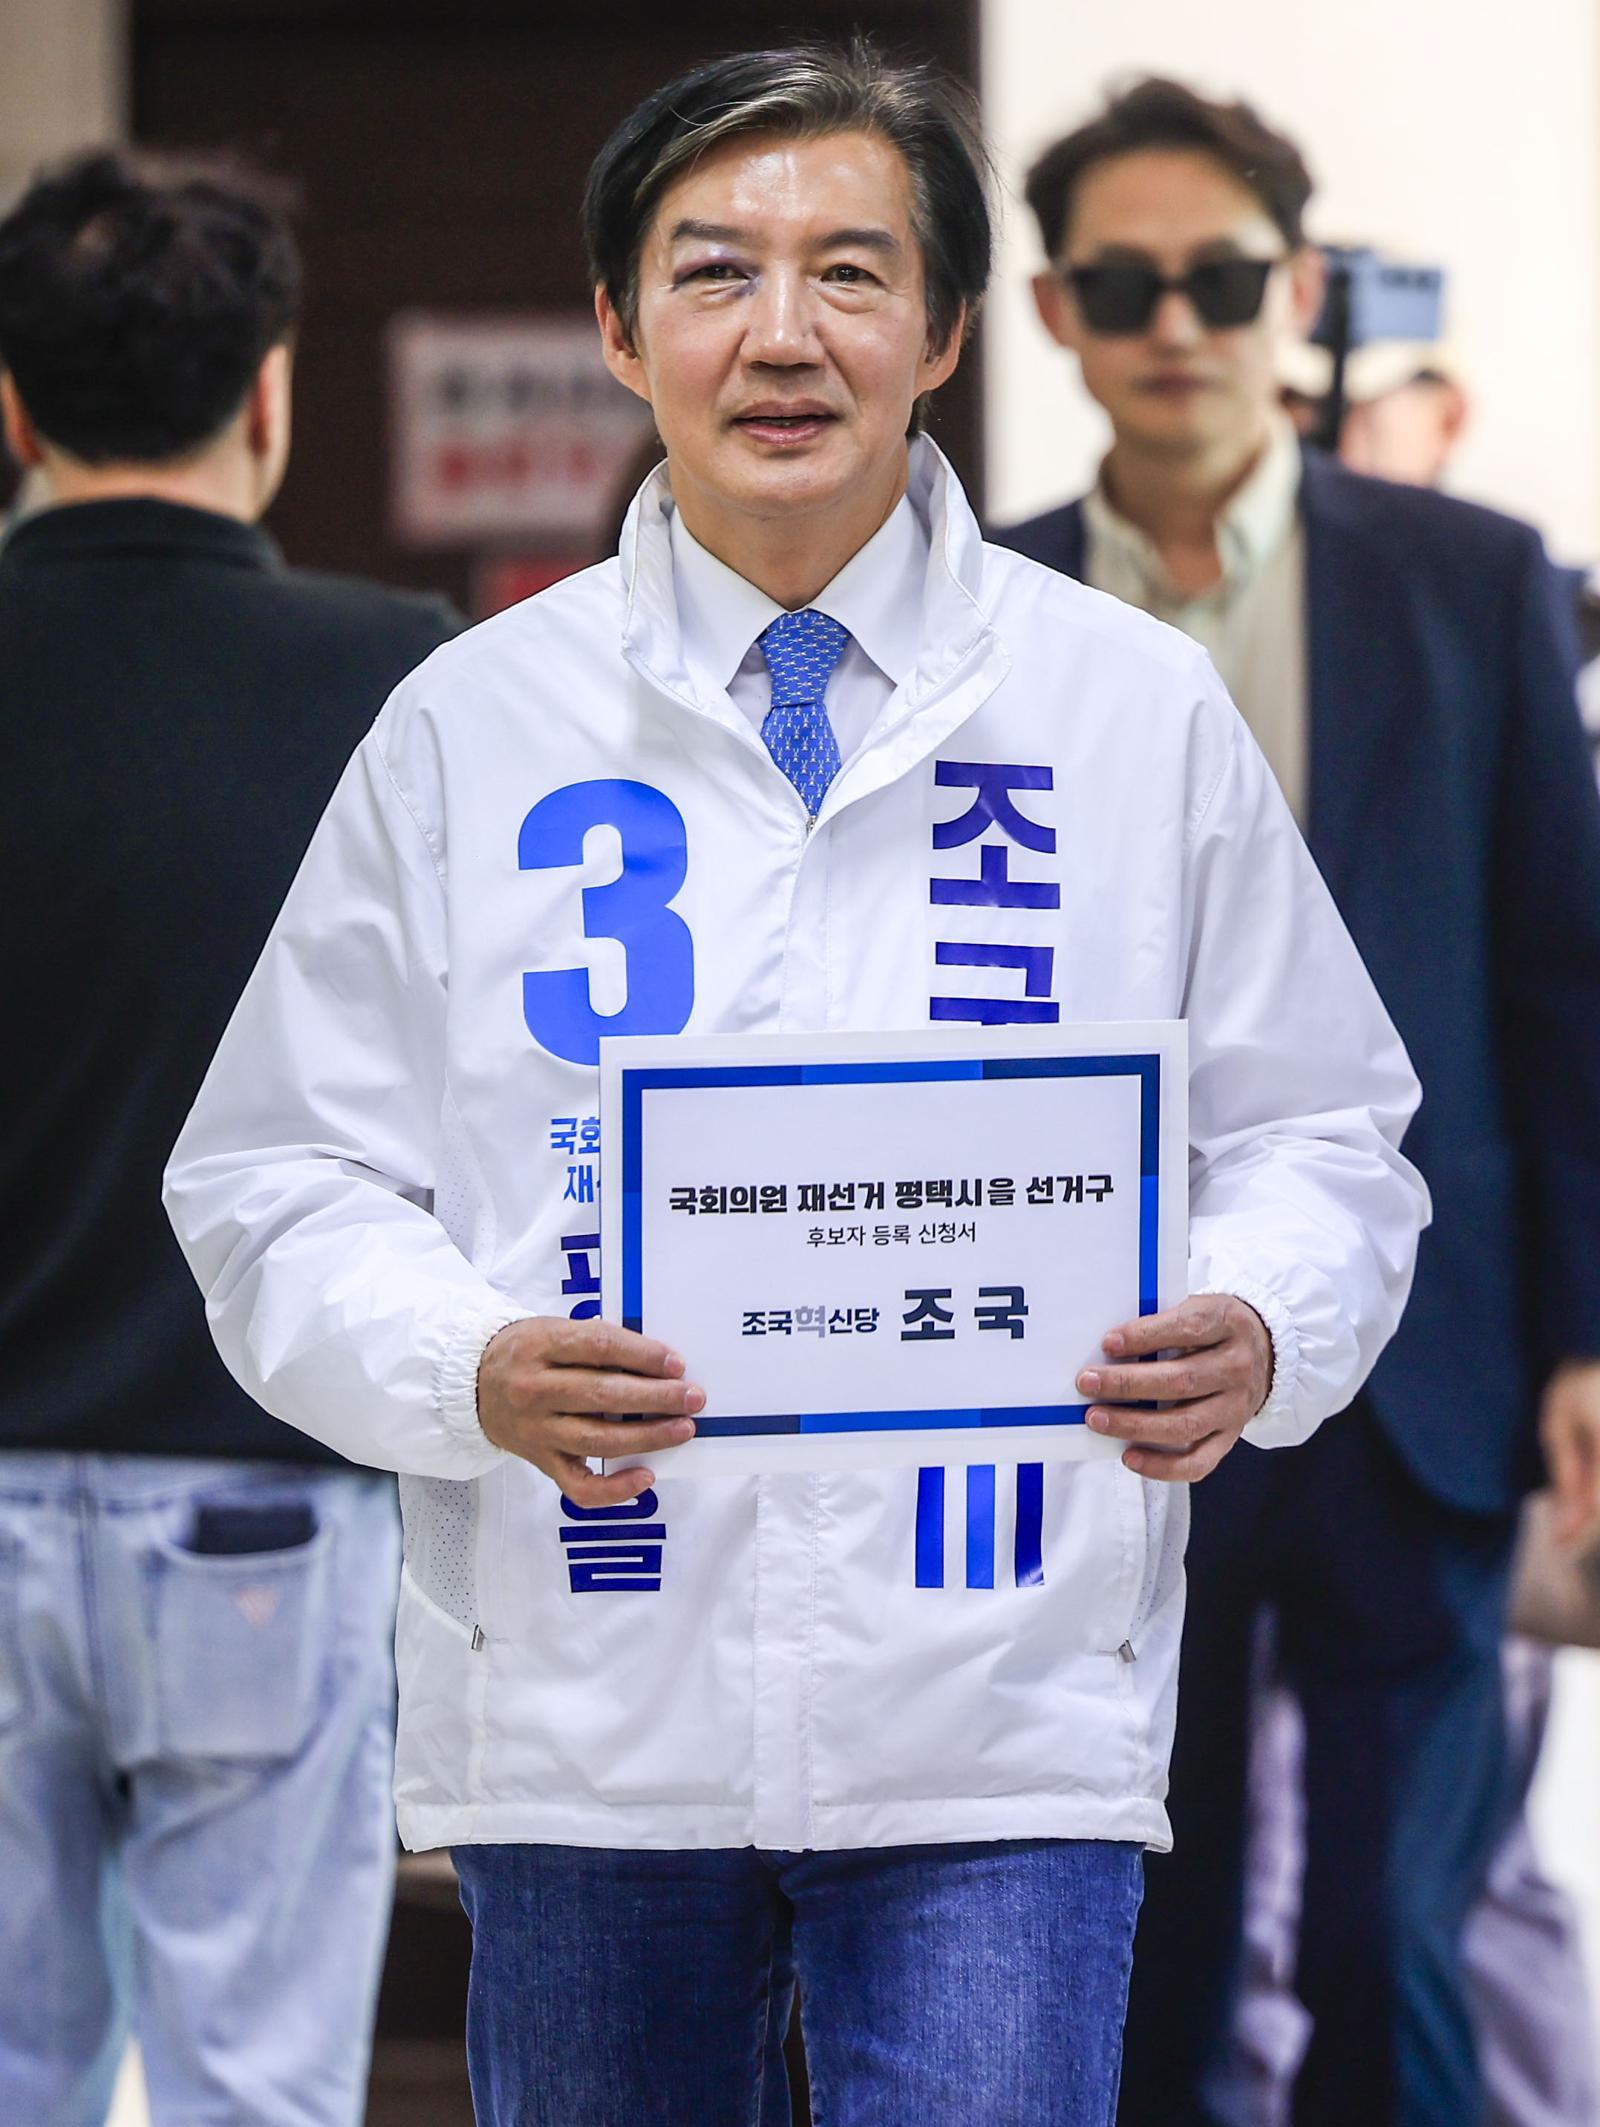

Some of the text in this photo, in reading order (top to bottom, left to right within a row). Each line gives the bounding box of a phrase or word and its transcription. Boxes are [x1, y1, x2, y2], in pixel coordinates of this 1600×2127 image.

[518, 778, 695, 1066] 3
[563, 1164, 600, 1203] 재
[669, 1174, 1114, 1215] 국회의원 재선거 평택시을 선거구
[806, 1221, 976, 1248] 후보자 등록 신청서
[742, 1305, 880, 1338] 조국혁신당
